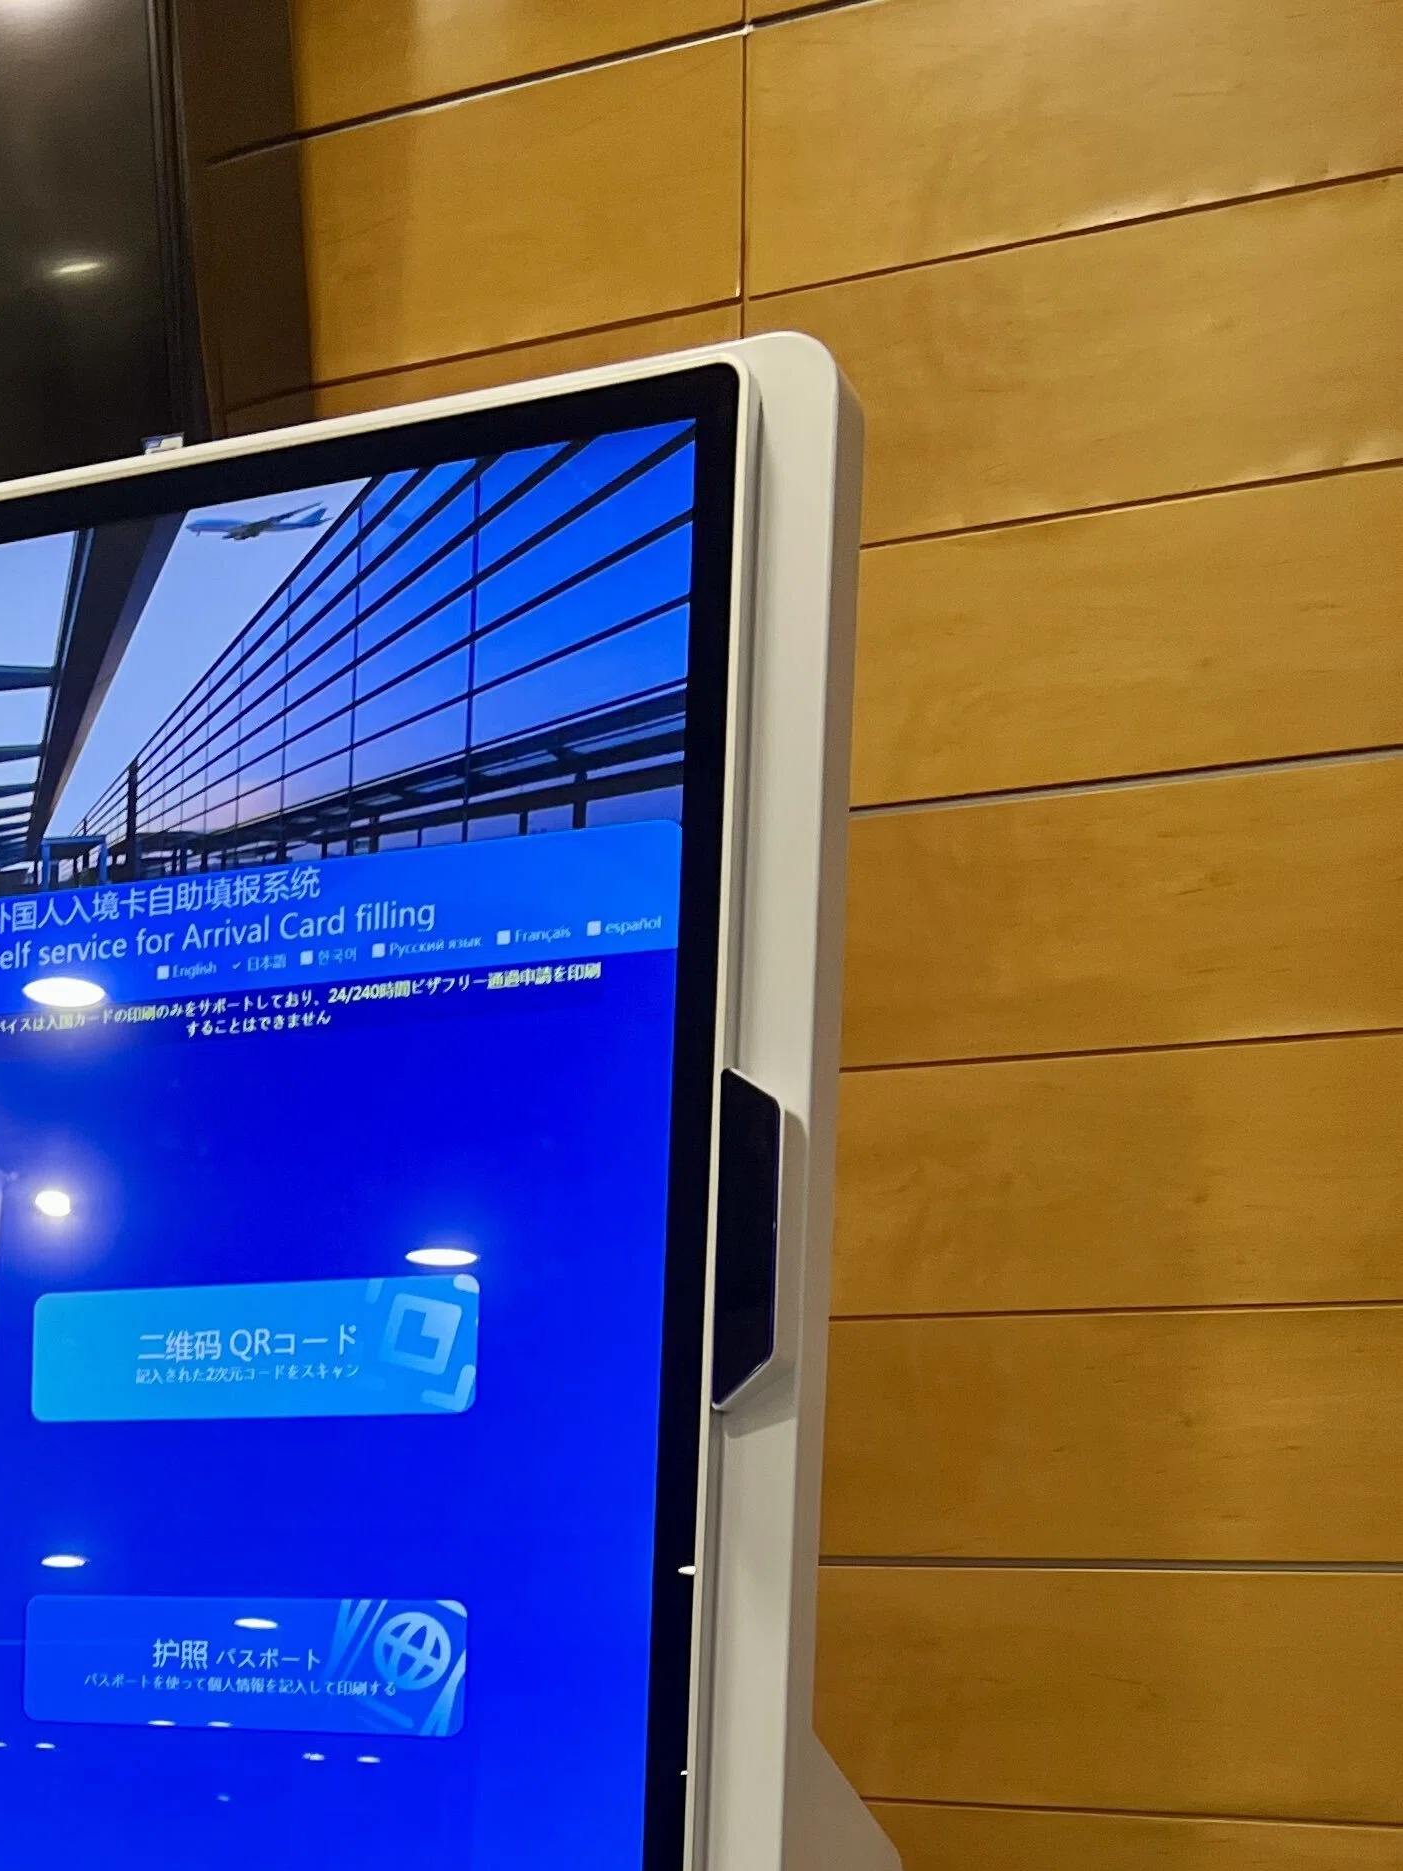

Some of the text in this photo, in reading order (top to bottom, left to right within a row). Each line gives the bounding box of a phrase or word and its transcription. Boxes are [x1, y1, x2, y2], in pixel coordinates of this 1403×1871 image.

[37, 932, 128, 966] service
[136, 928, 175, 955] for
[182, 914, 270, 951] Arrival
[279, 904, 346, 941] Card
[356, 900, 436, 933] filling
[514, 924, 572, 943] Français
[604, 915, 662, 936] español
[389, 935, 482, 959] Русский язык
[172, 961, 217, 979] English
[247, 953, 287, 972] 日本語
[186, 1009, 332, 1039] することはできません
[137, 1324, 357, 1363] 二维码 QRコード
[152, 1638, 321, 1672] 护照 パスポート
